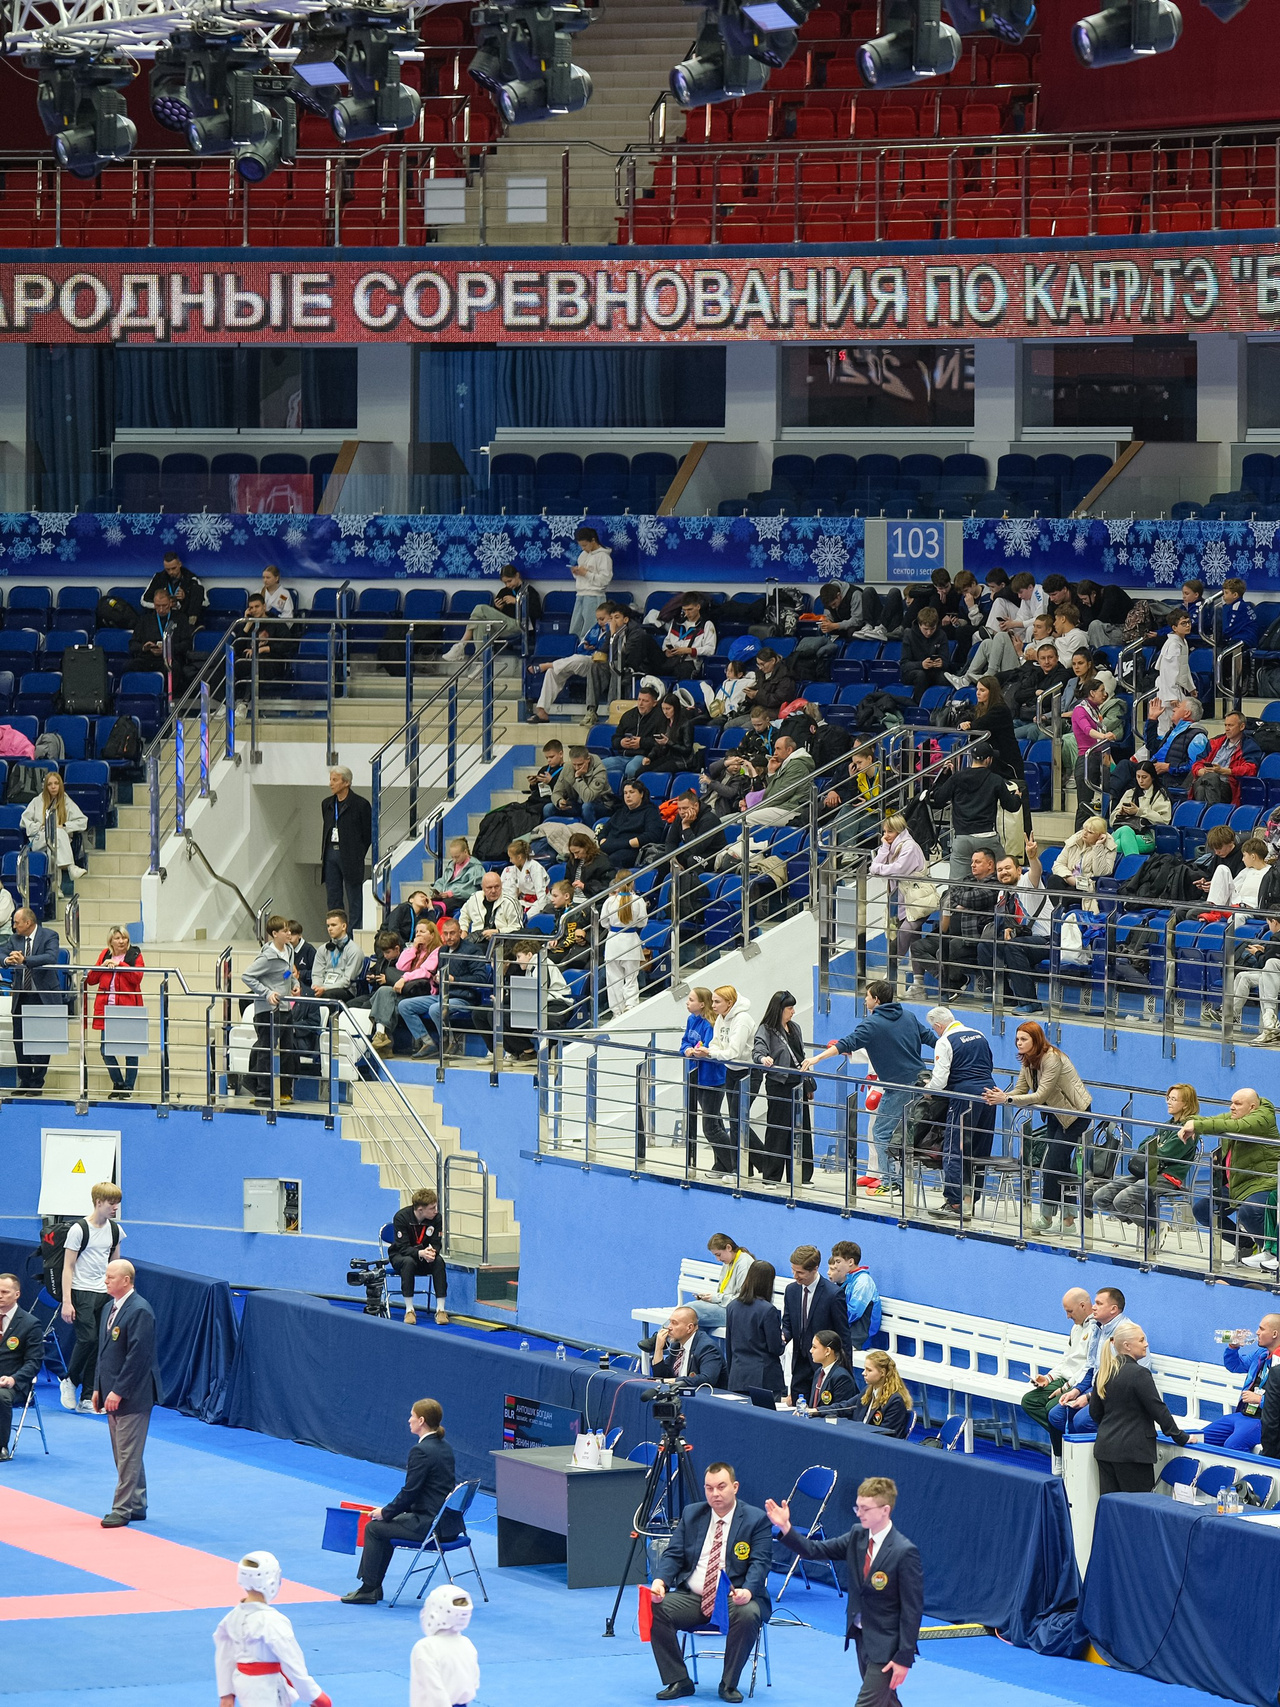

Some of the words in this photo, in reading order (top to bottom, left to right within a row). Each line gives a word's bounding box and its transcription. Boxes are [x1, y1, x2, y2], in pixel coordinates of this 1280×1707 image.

[353, 266, 908, 328] СОРЕВНОВАНИЯ
[926, 263, 1008, 323] ПО
[893, 527, 940, 559] 103
[893, 568, 915, 576] сектор
[504, 1408, 515, 1419] BLR
